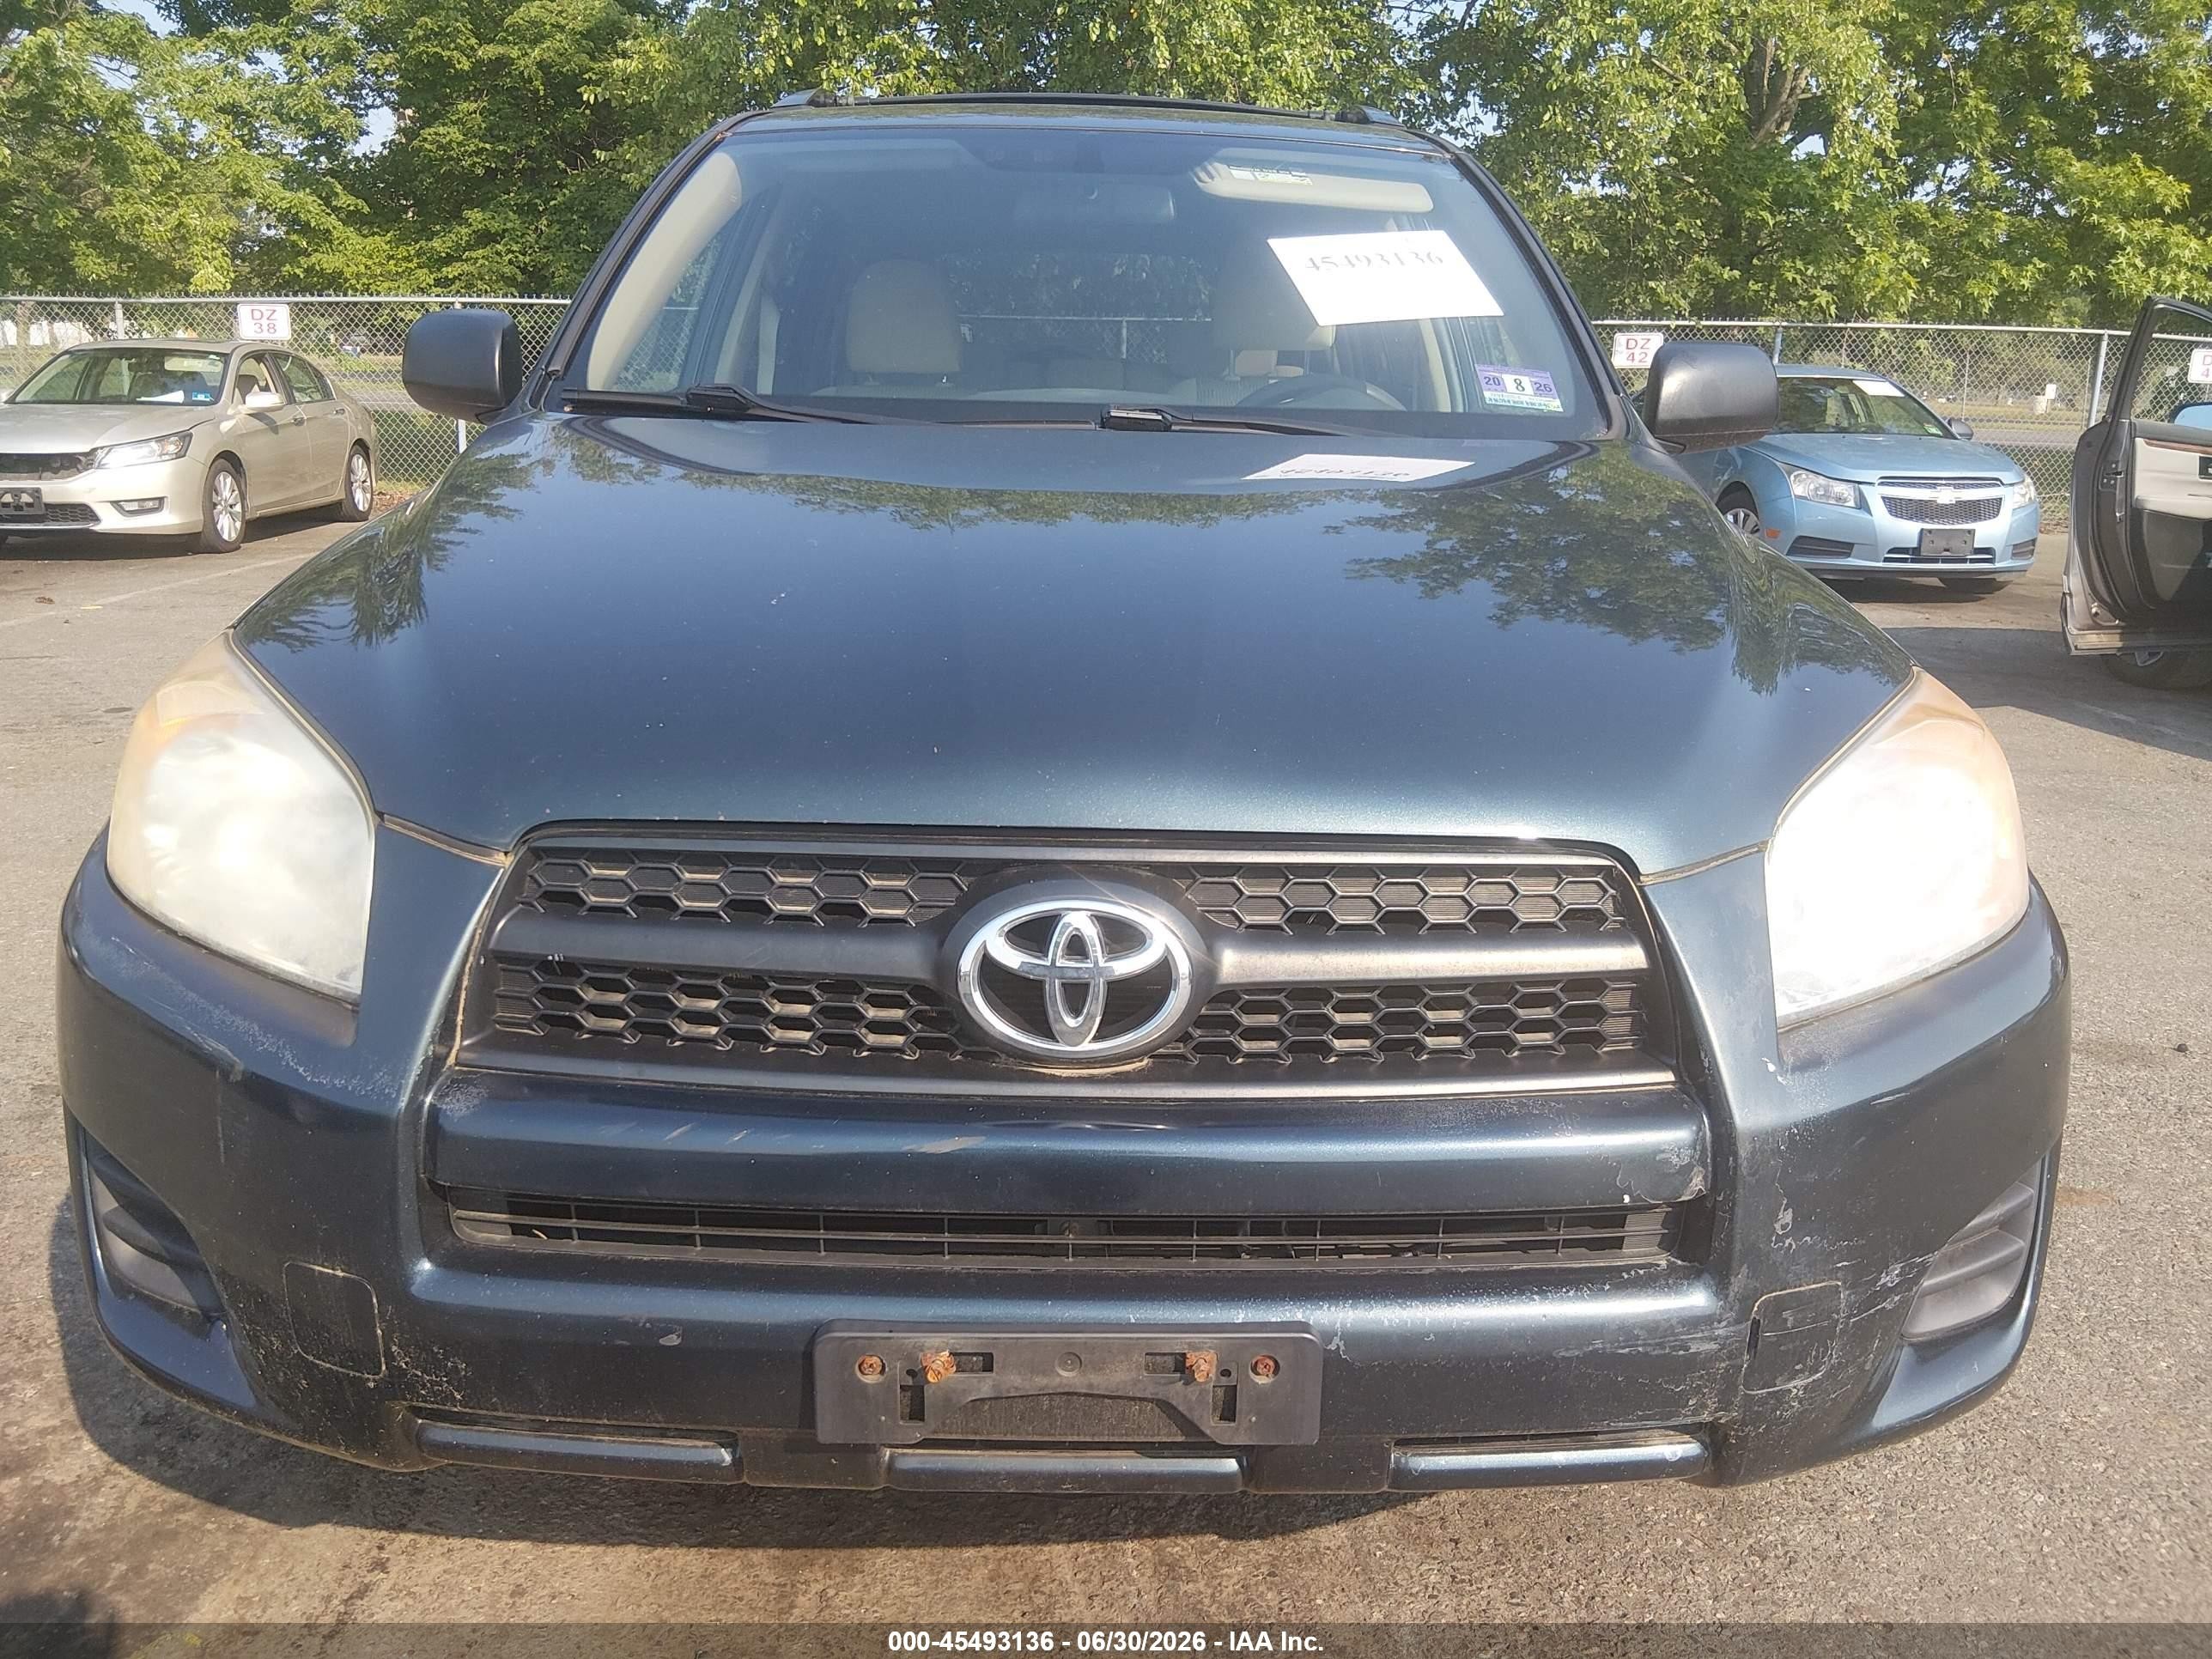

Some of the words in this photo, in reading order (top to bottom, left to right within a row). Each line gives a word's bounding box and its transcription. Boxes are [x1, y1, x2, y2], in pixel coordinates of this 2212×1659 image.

[251, 308, 278, 321] DZ
[253, 322, 277, 334] 38
[1626, 337, 1651, 350] DZ
[1626, 351, 1649, 363] 42
[1483, 376, 1501, 386] 20
[1513, 378, 1526, 392] 8
[1534, 382, 1553, 393] 26
